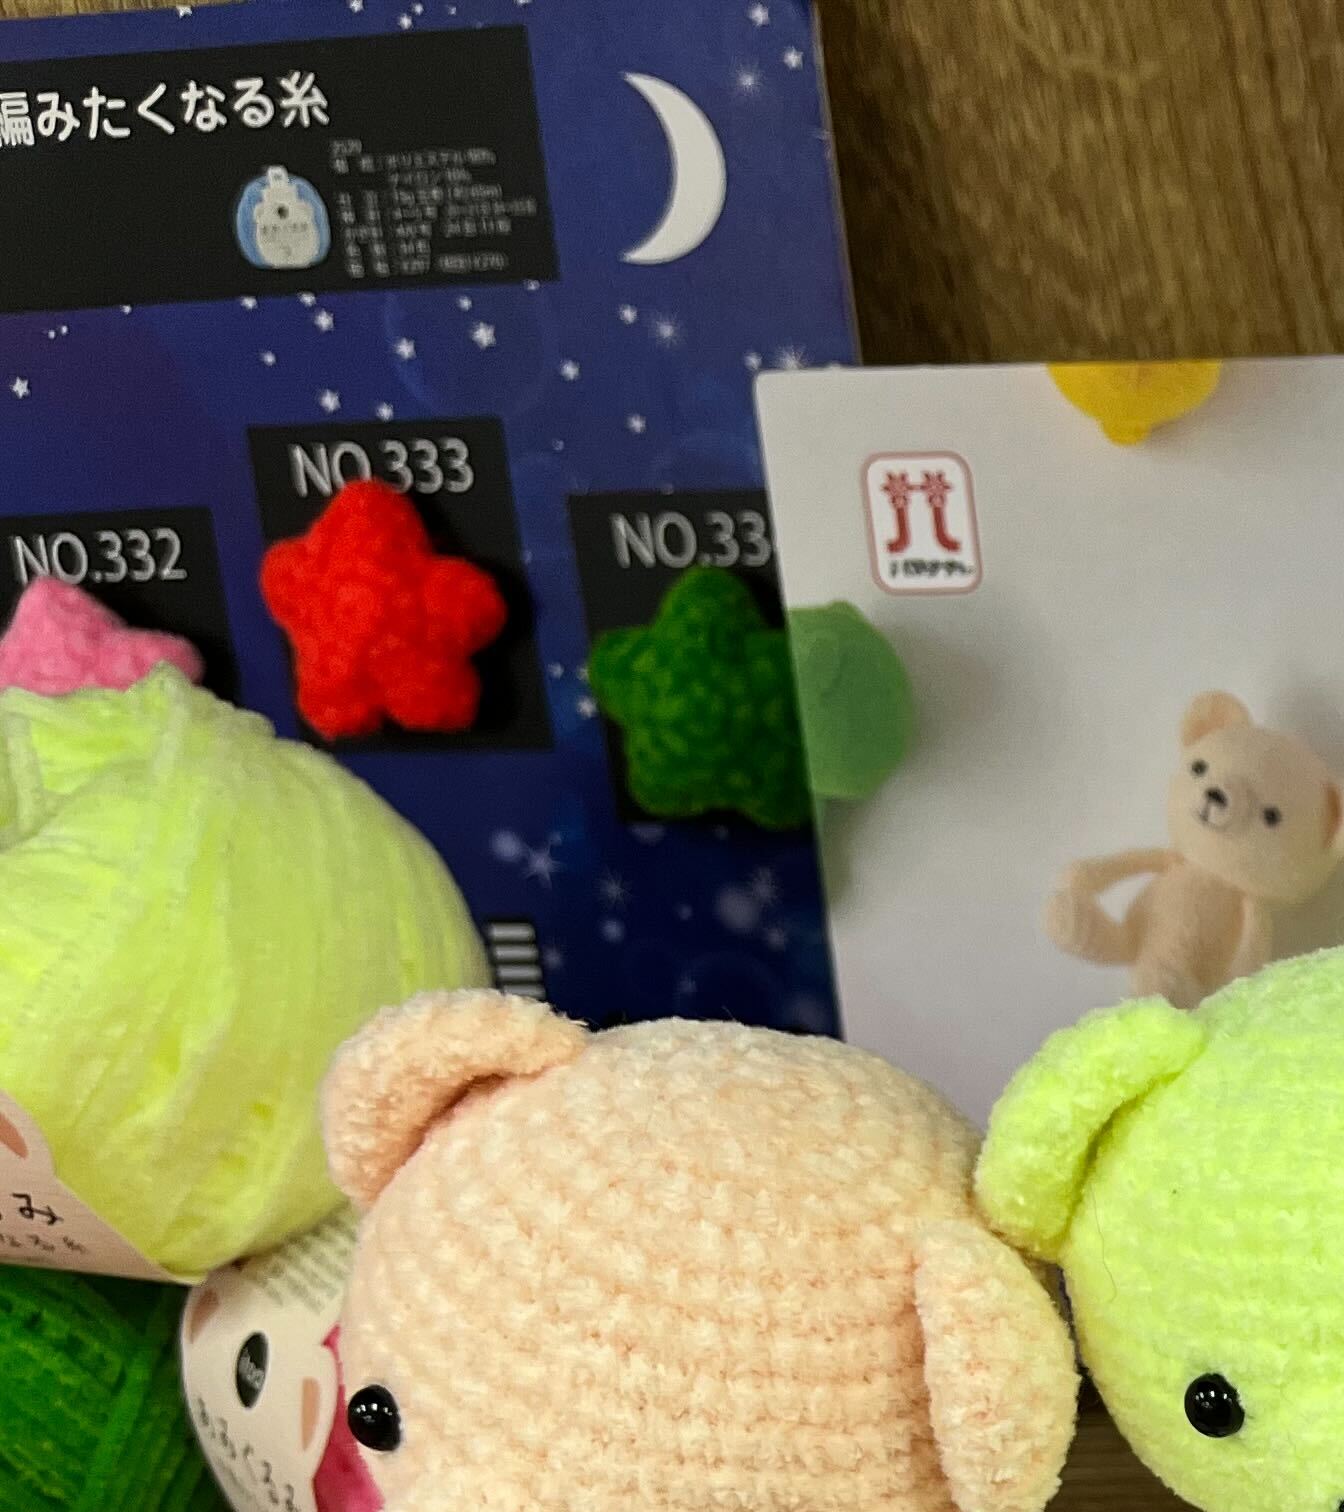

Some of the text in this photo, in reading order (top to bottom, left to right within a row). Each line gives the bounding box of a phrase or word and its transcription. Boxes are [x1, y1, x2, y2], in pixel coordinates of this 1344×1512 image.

[288, 438, 475, 497] NO333
[8, 528, 188, 585] NO.332
[609, 511, 772, 568] NO.33
